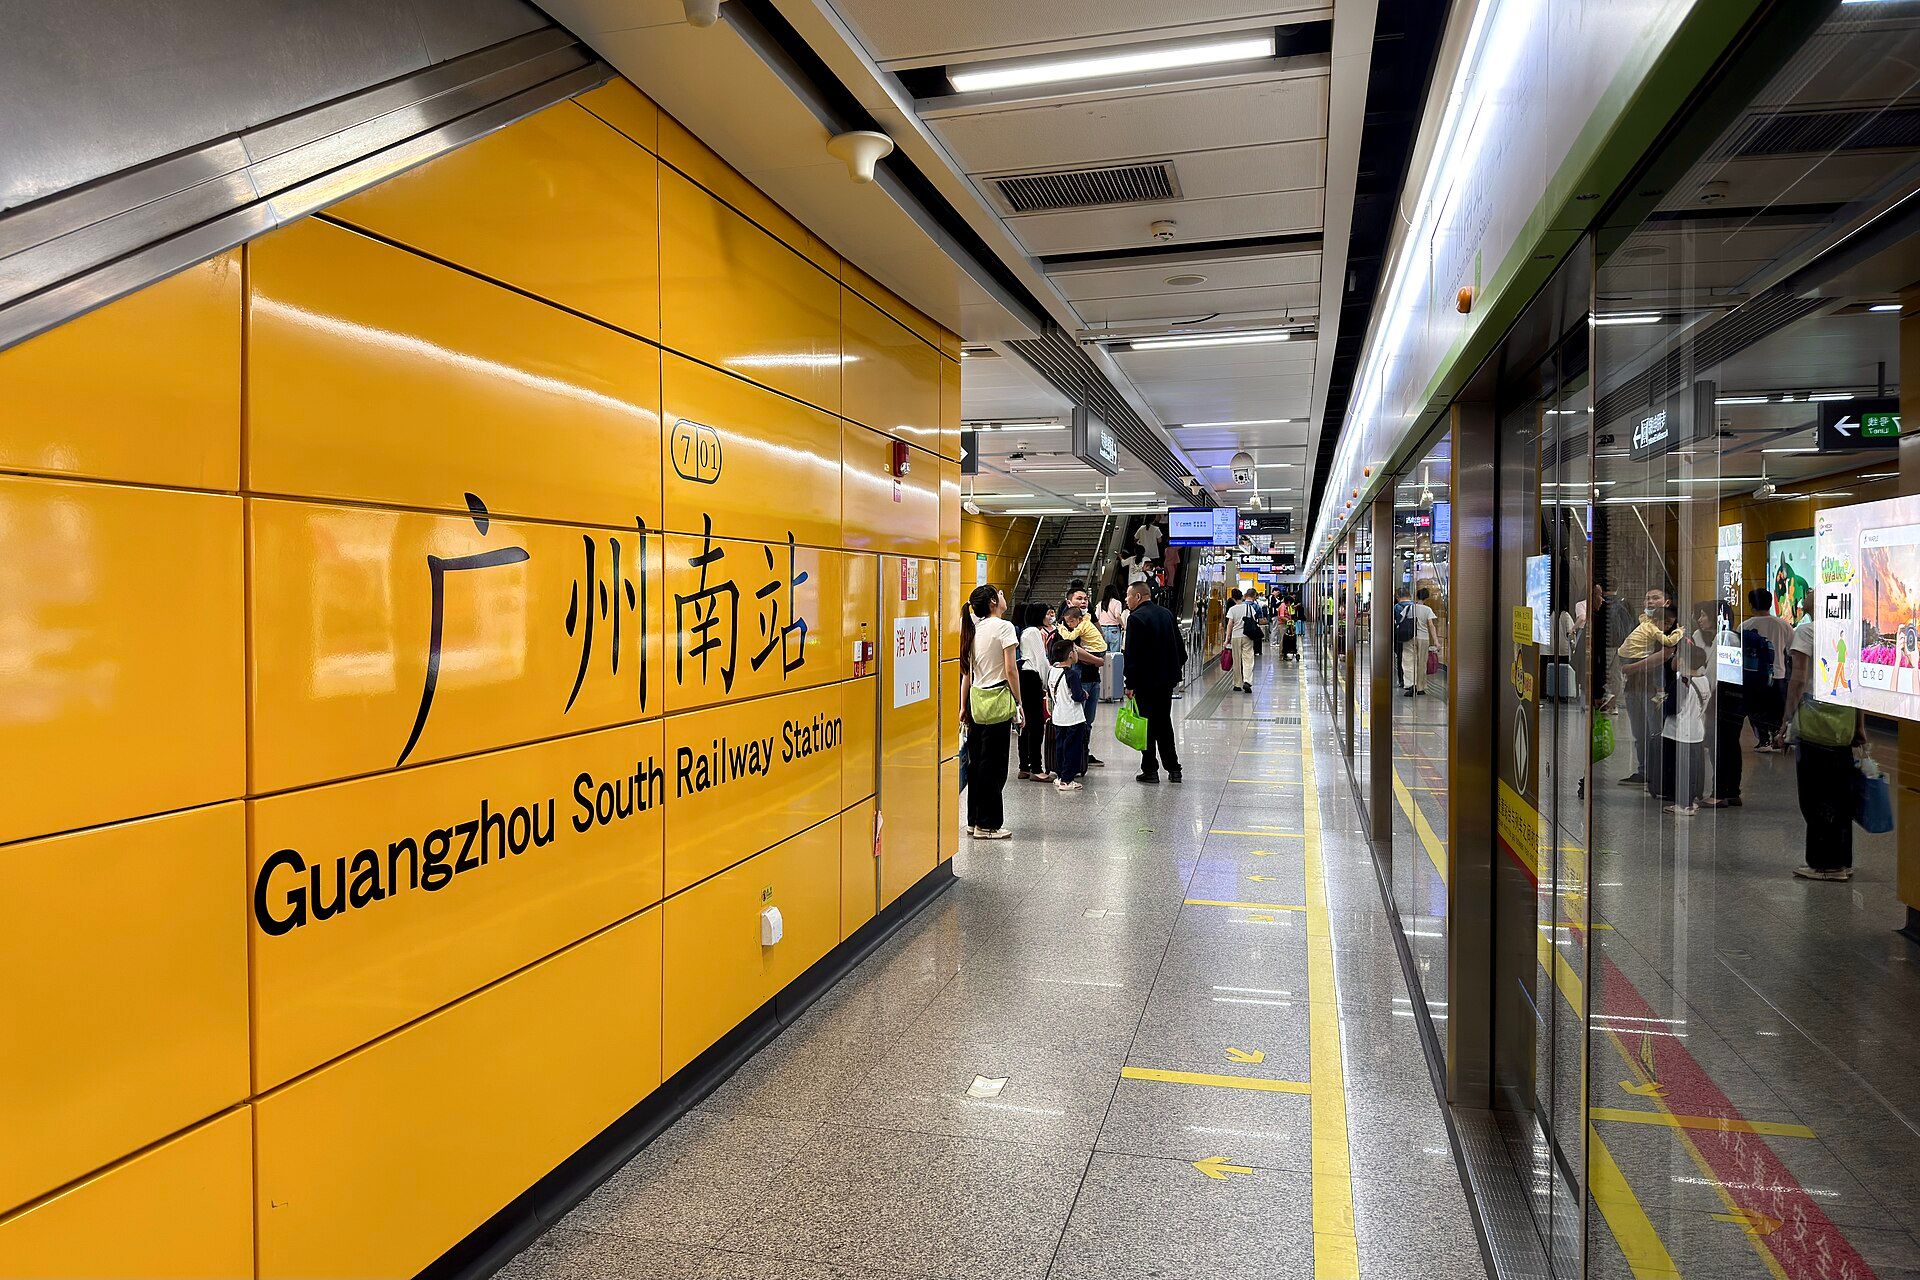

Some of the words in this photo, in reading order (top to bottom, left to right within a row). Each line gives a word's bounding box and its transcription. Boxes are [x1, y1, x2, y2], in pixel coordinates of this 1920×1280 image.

[396, 491, 809, 768] 广州南站
[896, 625, 929, 658] 消火栓
[254, 798, 557, 937] Guangzhou
[572, 756, 664, 834] South
[676, 733, 774, 799] Railway
[782, 713, 843, 766] Station
